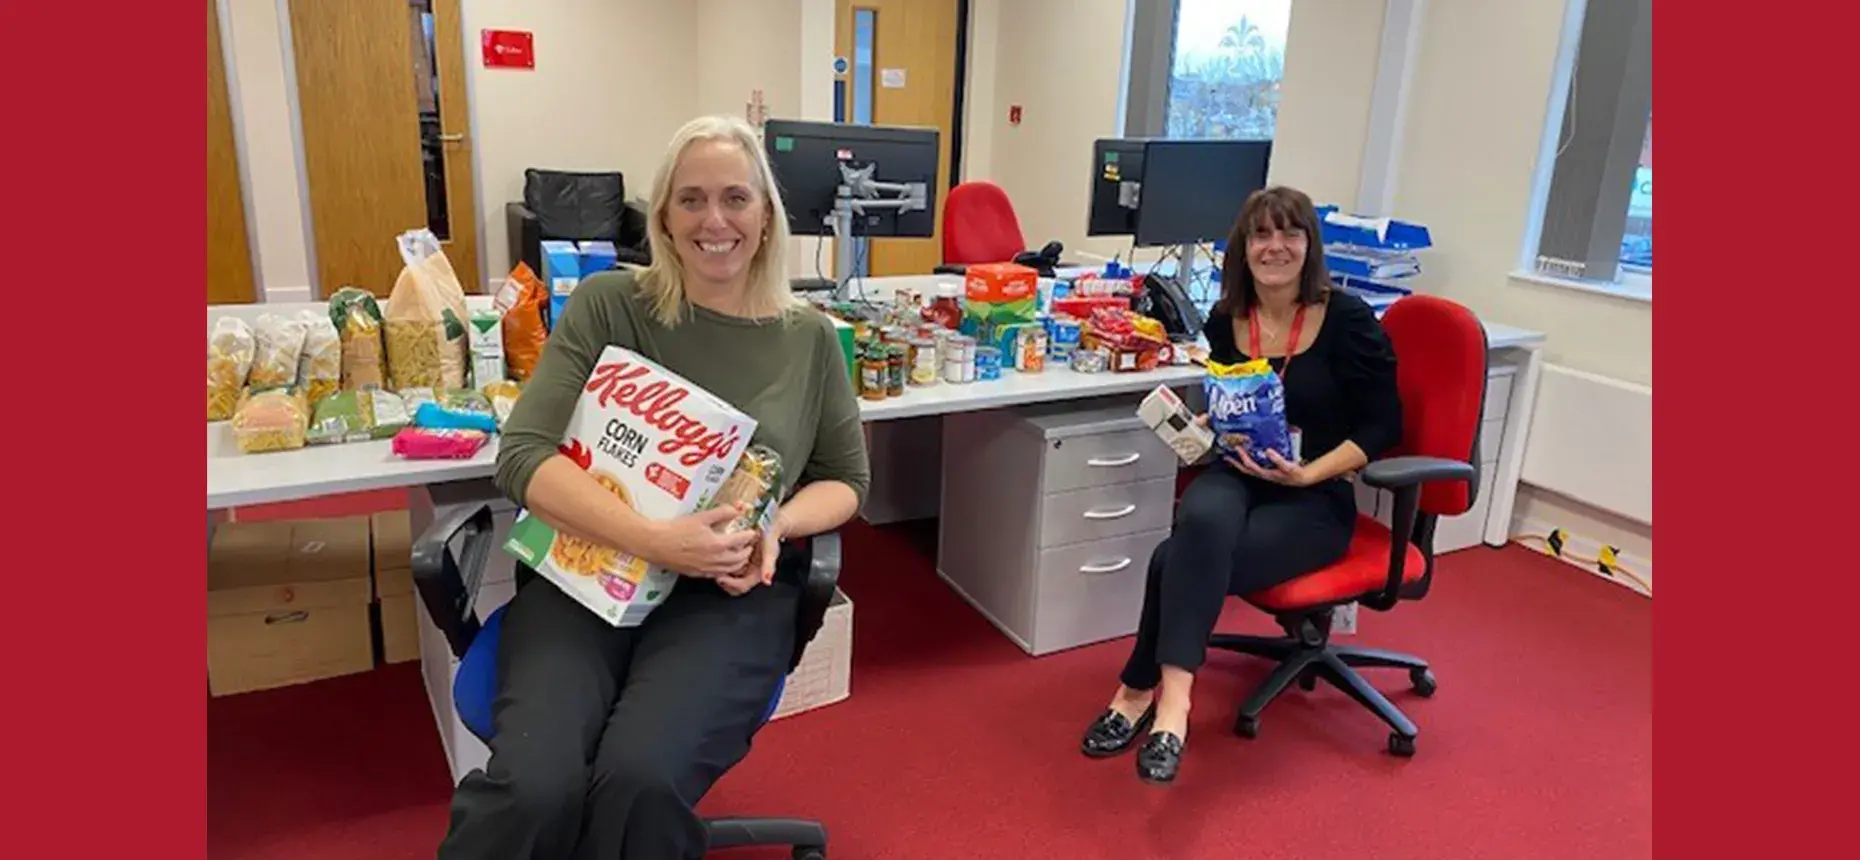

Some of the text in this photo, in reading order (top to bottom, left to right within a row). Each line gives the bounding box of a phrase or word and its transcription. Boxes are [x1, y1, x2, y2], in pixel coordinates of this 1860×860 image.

[586, 362, 740, 467] Kellogg's
[1208, 385, 1257, 421] Alpen
[597, 435, 639, 469] FLAKES
[605, 417, 649, 455] CORN
